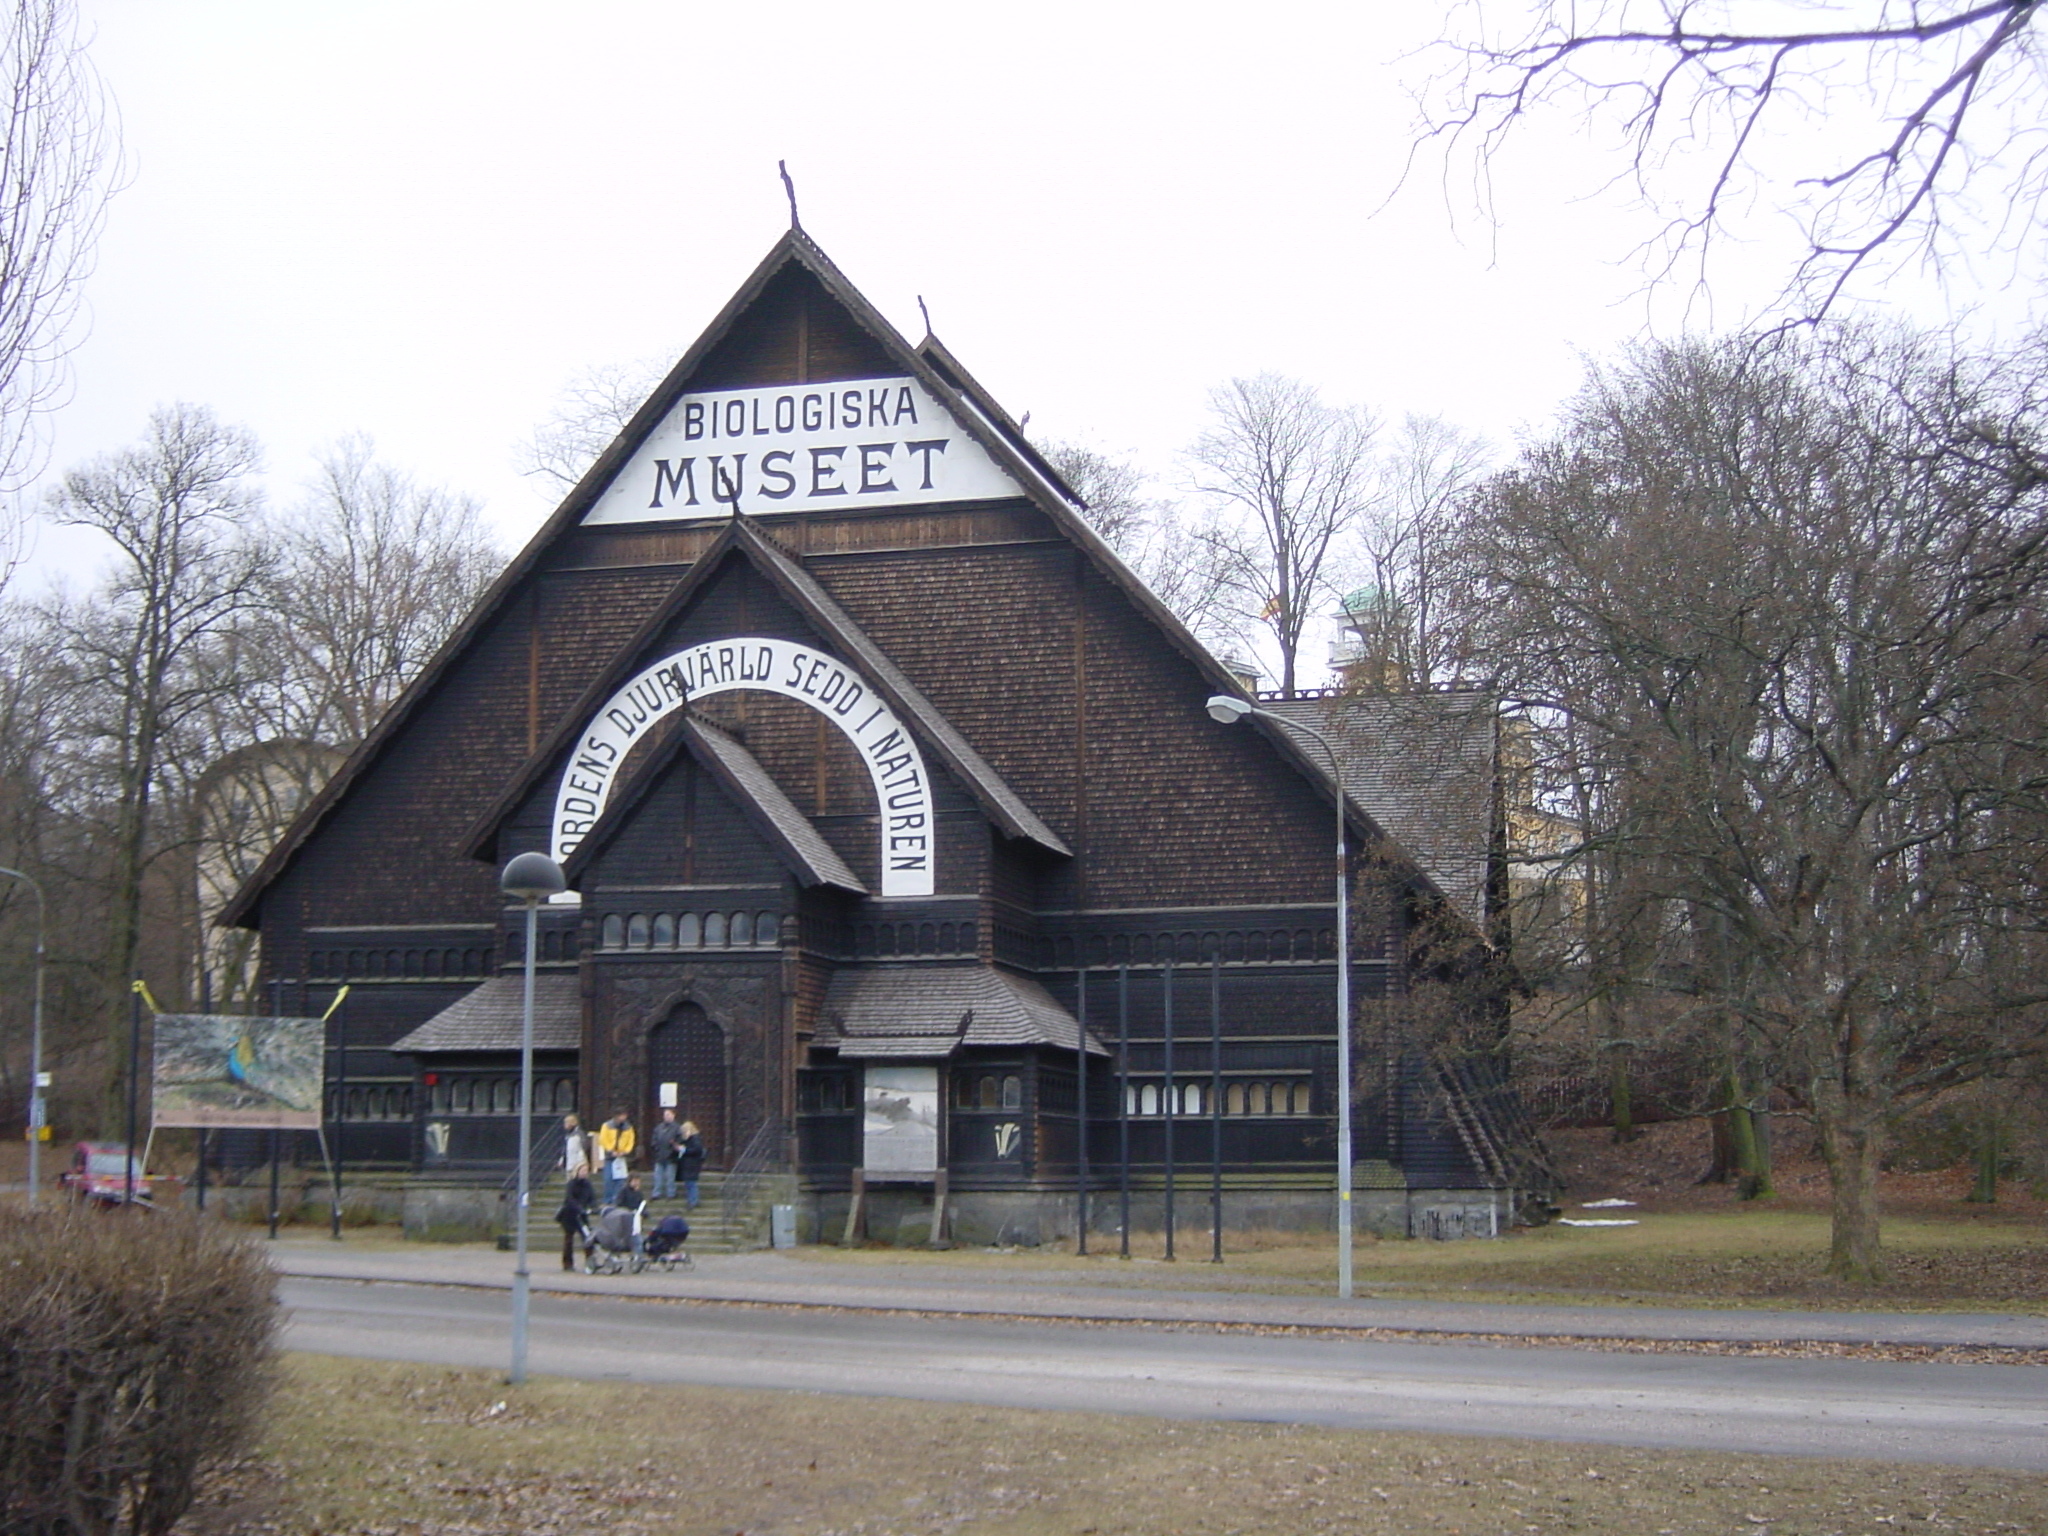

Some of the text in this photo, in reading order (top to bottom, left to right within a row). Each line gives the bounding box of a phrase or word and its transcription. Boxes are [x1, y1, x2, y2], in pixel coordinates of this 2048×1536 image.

[684, 386, 918, 441] BIOLOGISKA
[648, 438, 951, 508] MUSEET
[559, 645, 927, 872] ORDENS DJURVÄRLD SEDD I NATUREN
